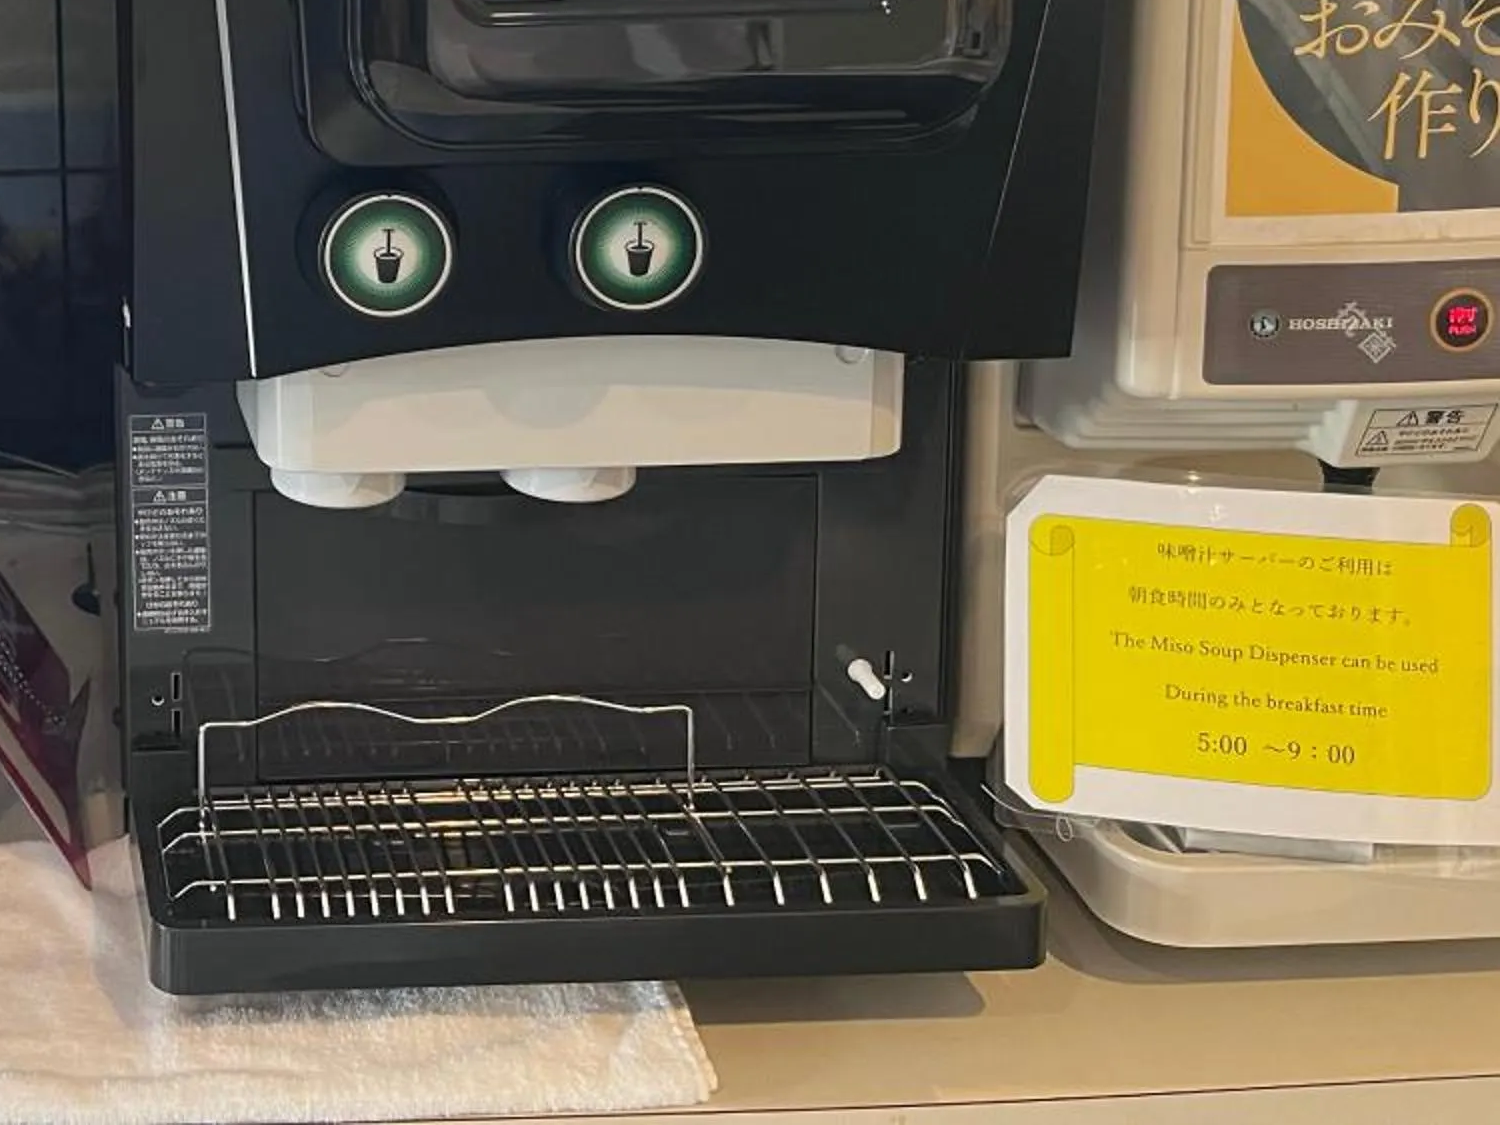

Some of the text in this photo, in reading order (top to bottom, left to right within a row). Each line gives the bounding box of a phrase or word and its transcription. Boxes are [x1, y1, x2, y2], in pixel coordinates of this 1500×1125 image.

[1157, 542, 1393, 576] 味噌汁サーバーのご利用は
[1128, 585, 1410, 626] 朝食時間のみとなっております。
[1110, 631, 1439, 675] The Miso Soup Dispenser can be used
[1165, 683, 1388, 719] During the breakfast time
[1197, 731, 1248, 757] 5:00
